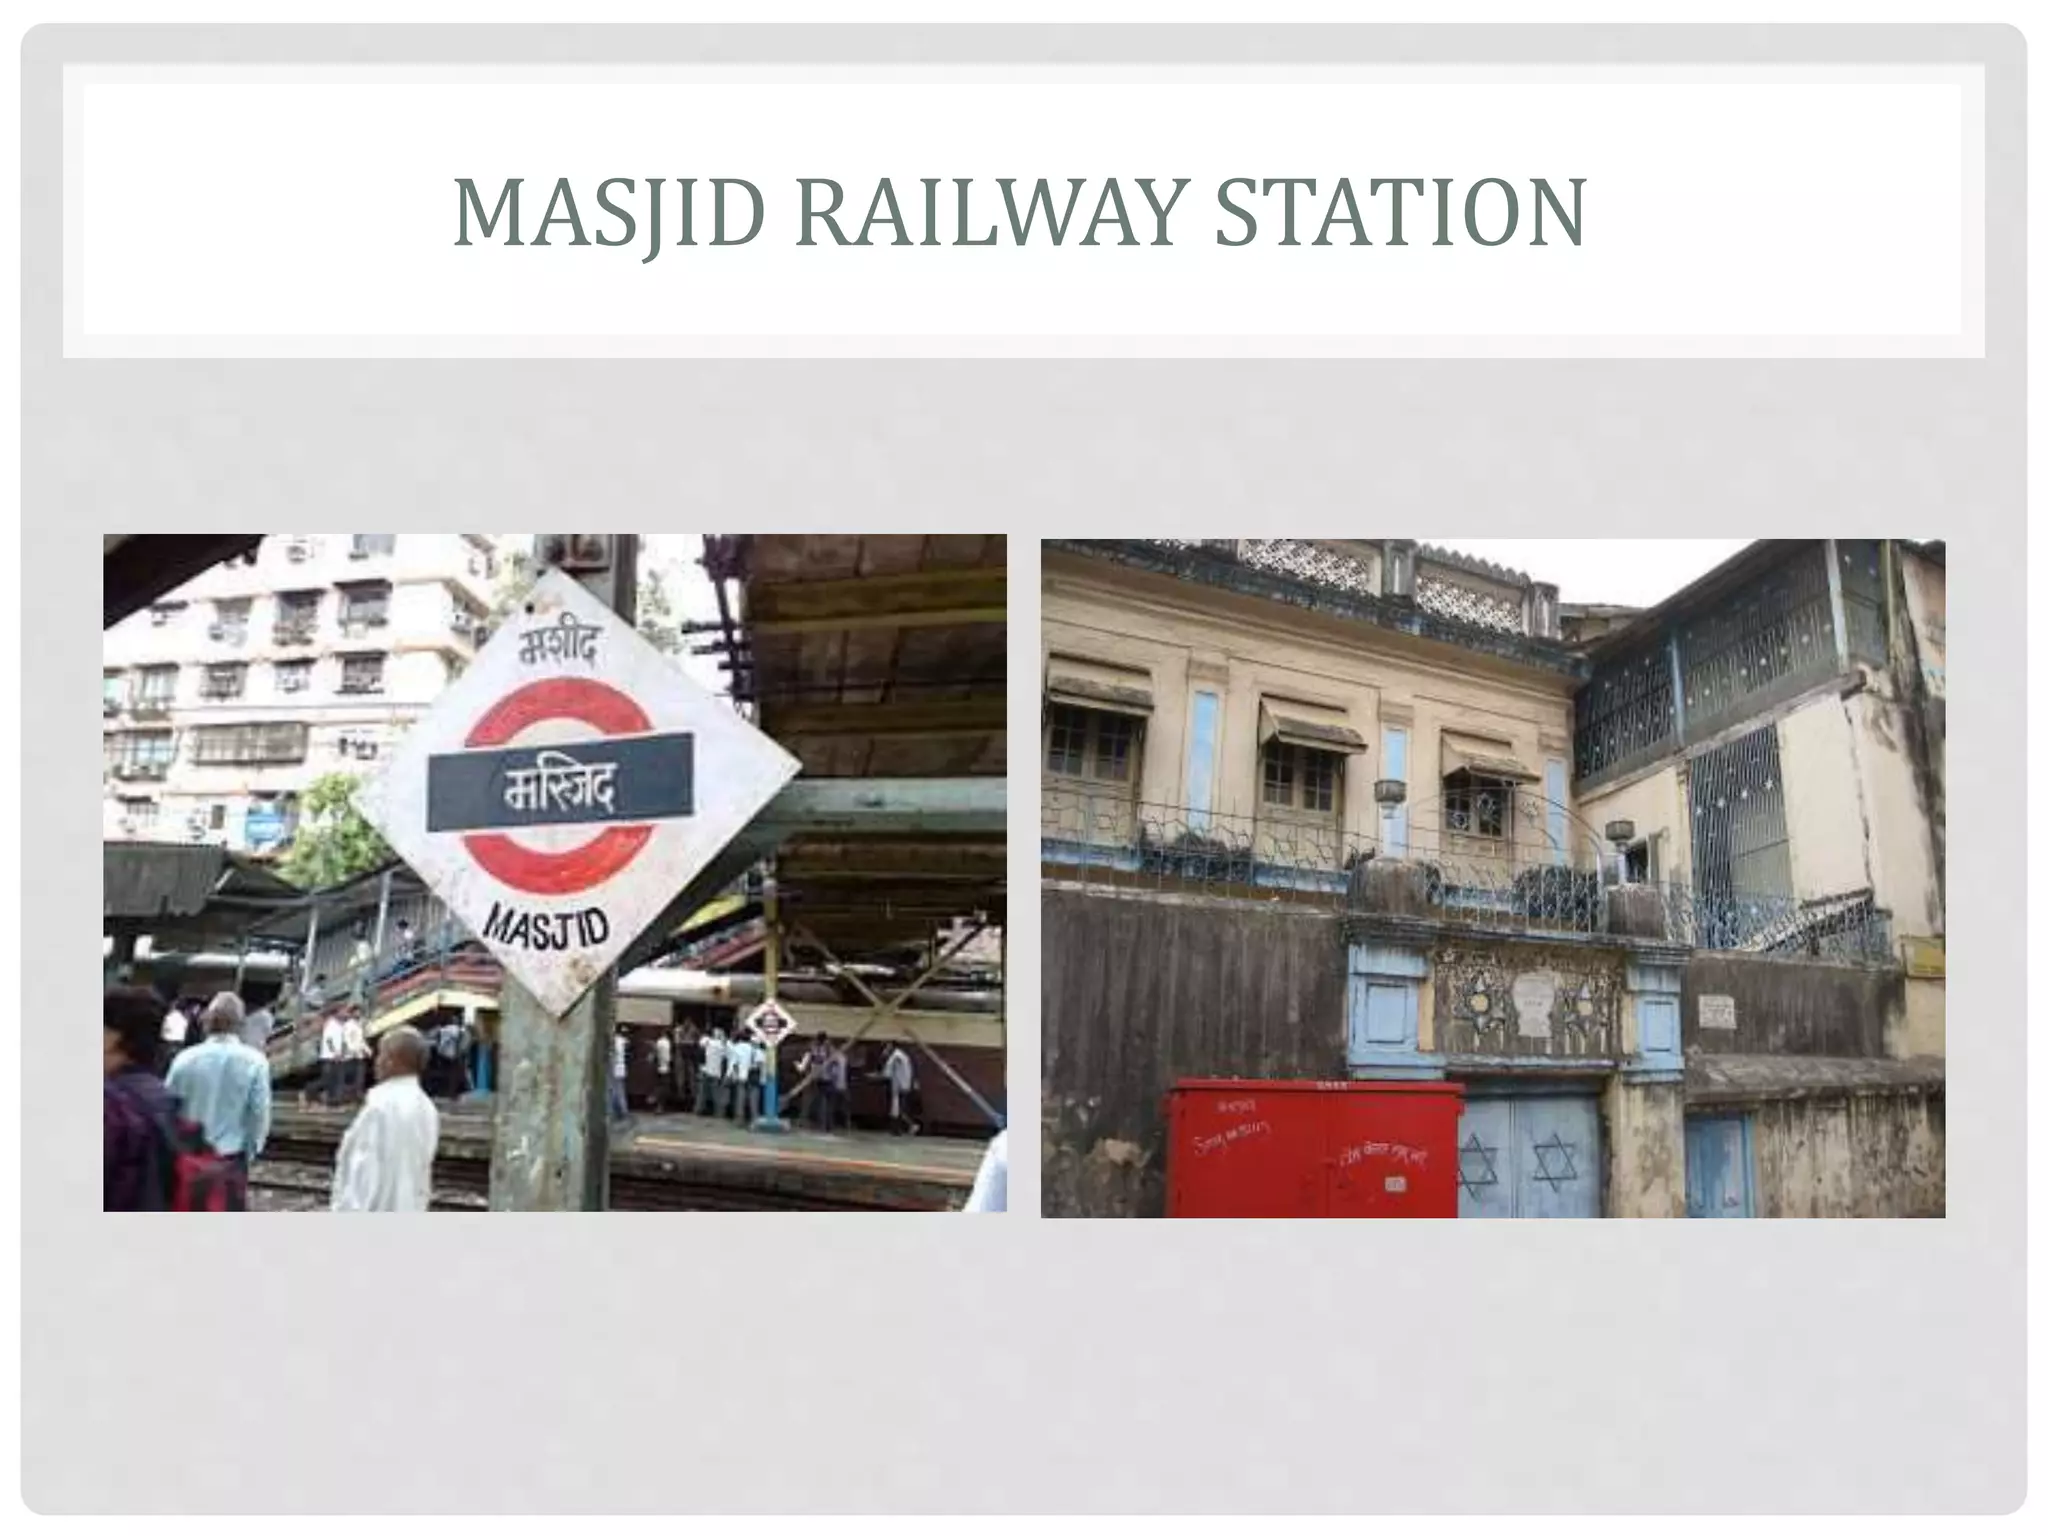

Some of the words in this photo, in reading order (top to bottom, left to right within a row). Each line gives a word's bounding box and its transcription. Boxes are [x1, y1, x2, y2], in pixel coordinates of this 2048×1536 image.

[519, 611, 604, 669] मशीद
[504, 750, 618, 814] मस्जिद
[482, 901, 610, 950] MASJID
